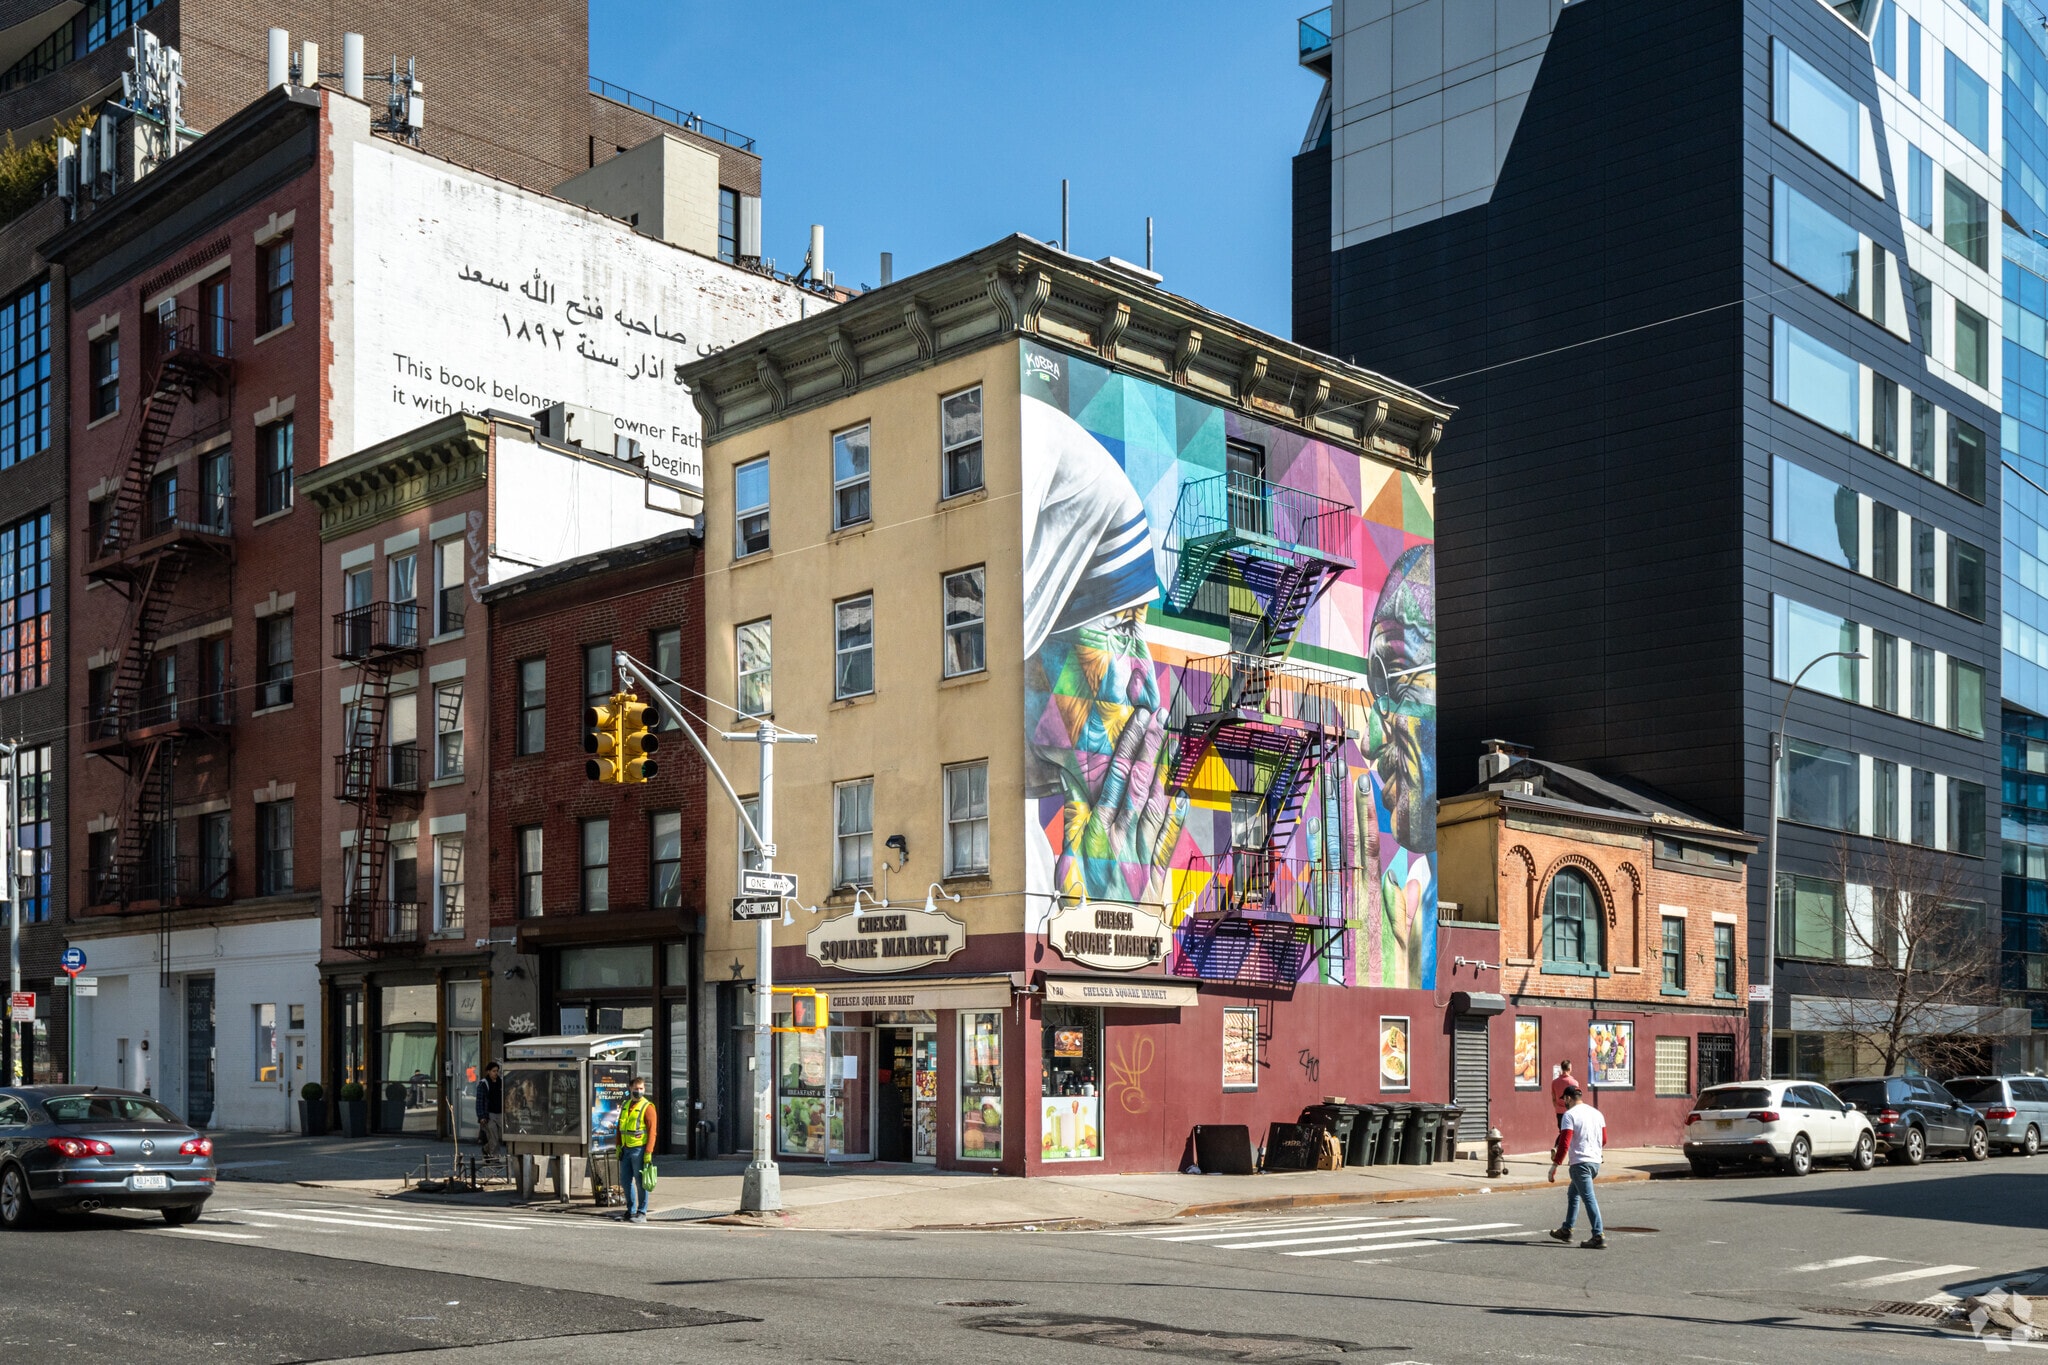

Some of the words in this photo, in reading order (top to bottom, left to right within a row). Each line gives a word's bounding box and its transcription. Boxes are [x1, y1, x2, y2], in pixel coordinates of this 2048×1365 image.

[458, 264, 509, 292] سعد
[566, 295, 603, 326] فتح
[502, 313, 565, 351] ١٨٩٢
[577, 333, 619, 367] سنة
[1025, 352, 1060, 378] KOBRA
[393, 352, 433, 380] This
[440, 365, 487, 394] book
[614, 417, 666, 439] owner
[393, 385, 406, 405] it
[412, 394, 452, 415] with
[750, 878, 767, 889] ONE
[773, 880, 789, 890] WAY
[740, 904, 755, 914] ONE
[760, 903, 776, 913] WAY
[858, 914, 907, 933] CHELSEA
[1095, 910, 1134, 931] CHELSEA
[820, 938, 878, 963] SQUARE
[881, 934, 949, 958] MARKET
[1065, 931, 1112, 957] SQUARE
[1114, 934, 1163, 959] MARKET
[188, 986, 210, 999] STORE
[460, 997, 476, 1011] 134
[832, 995, 860, 1007] CHELSEA
[861, 995, 887, 1007] SQUARE
[887, 995, 915, 1006] MARKET
[1083, 986, 1114, 997] CHELSEA
[1115, 987, 1140, 999] SQUARE
[1141, 988, 1167, 1000] MARKET
[188, 1002, 202, 1015] FOR
